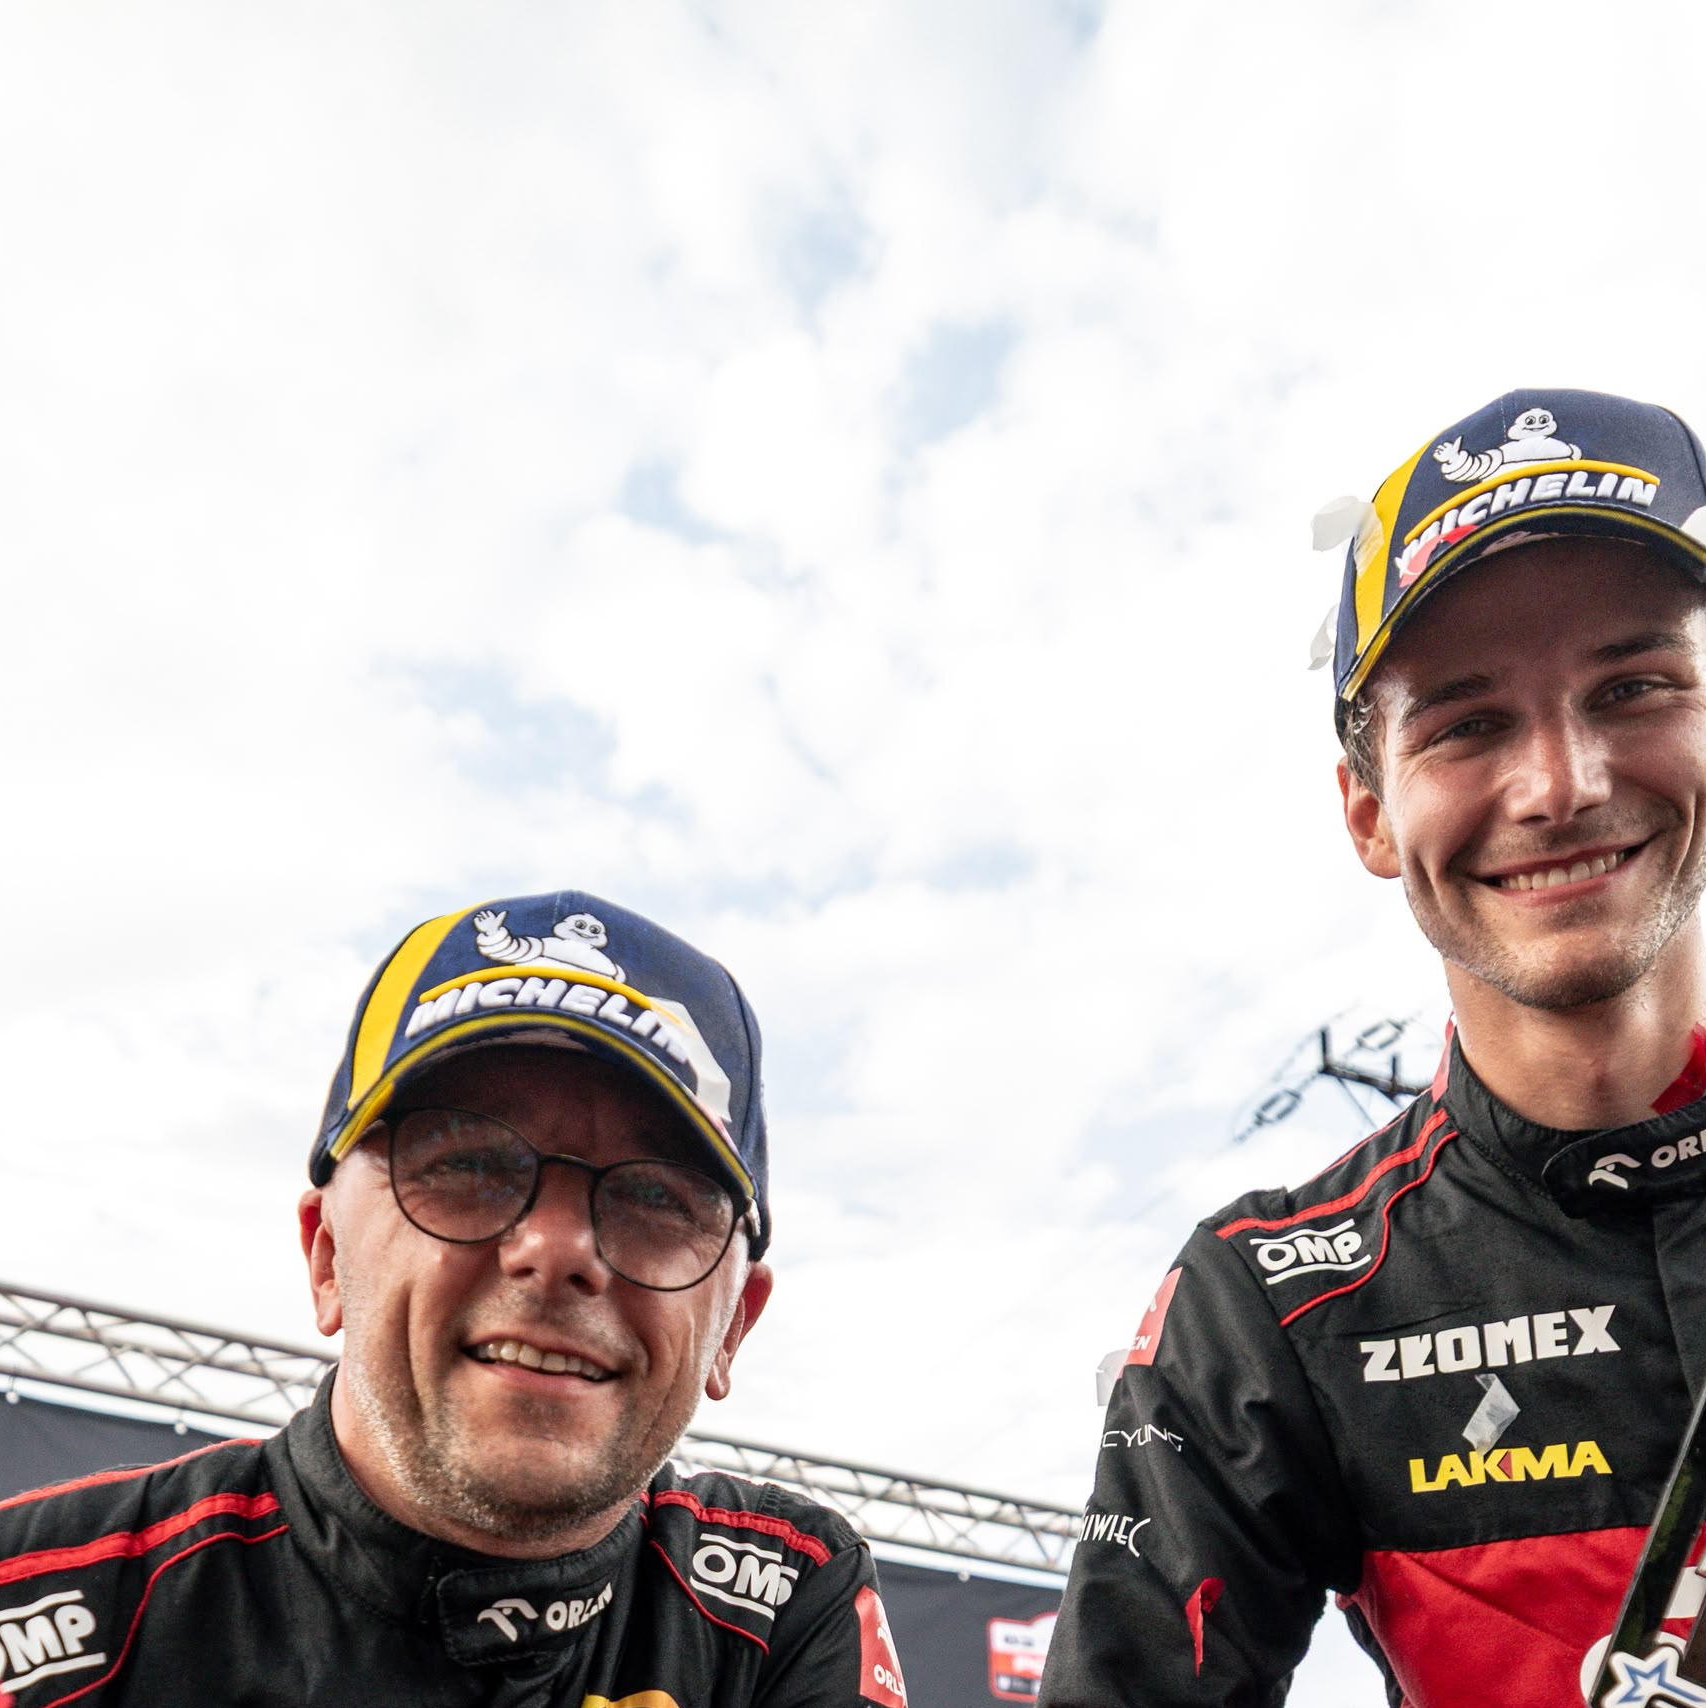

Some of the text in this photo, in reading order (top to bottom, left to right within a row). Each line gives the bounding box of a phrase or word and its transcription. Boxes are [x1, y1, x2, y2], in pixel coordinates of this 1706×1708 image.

[1394, 471, 1658, 577] MICHELIN
[405, 976, 692, 1064] MICHELIN
[1255, 1231, 1364, 1272] OMP
[1408, 1440, 1613, 1493] LAKMA
